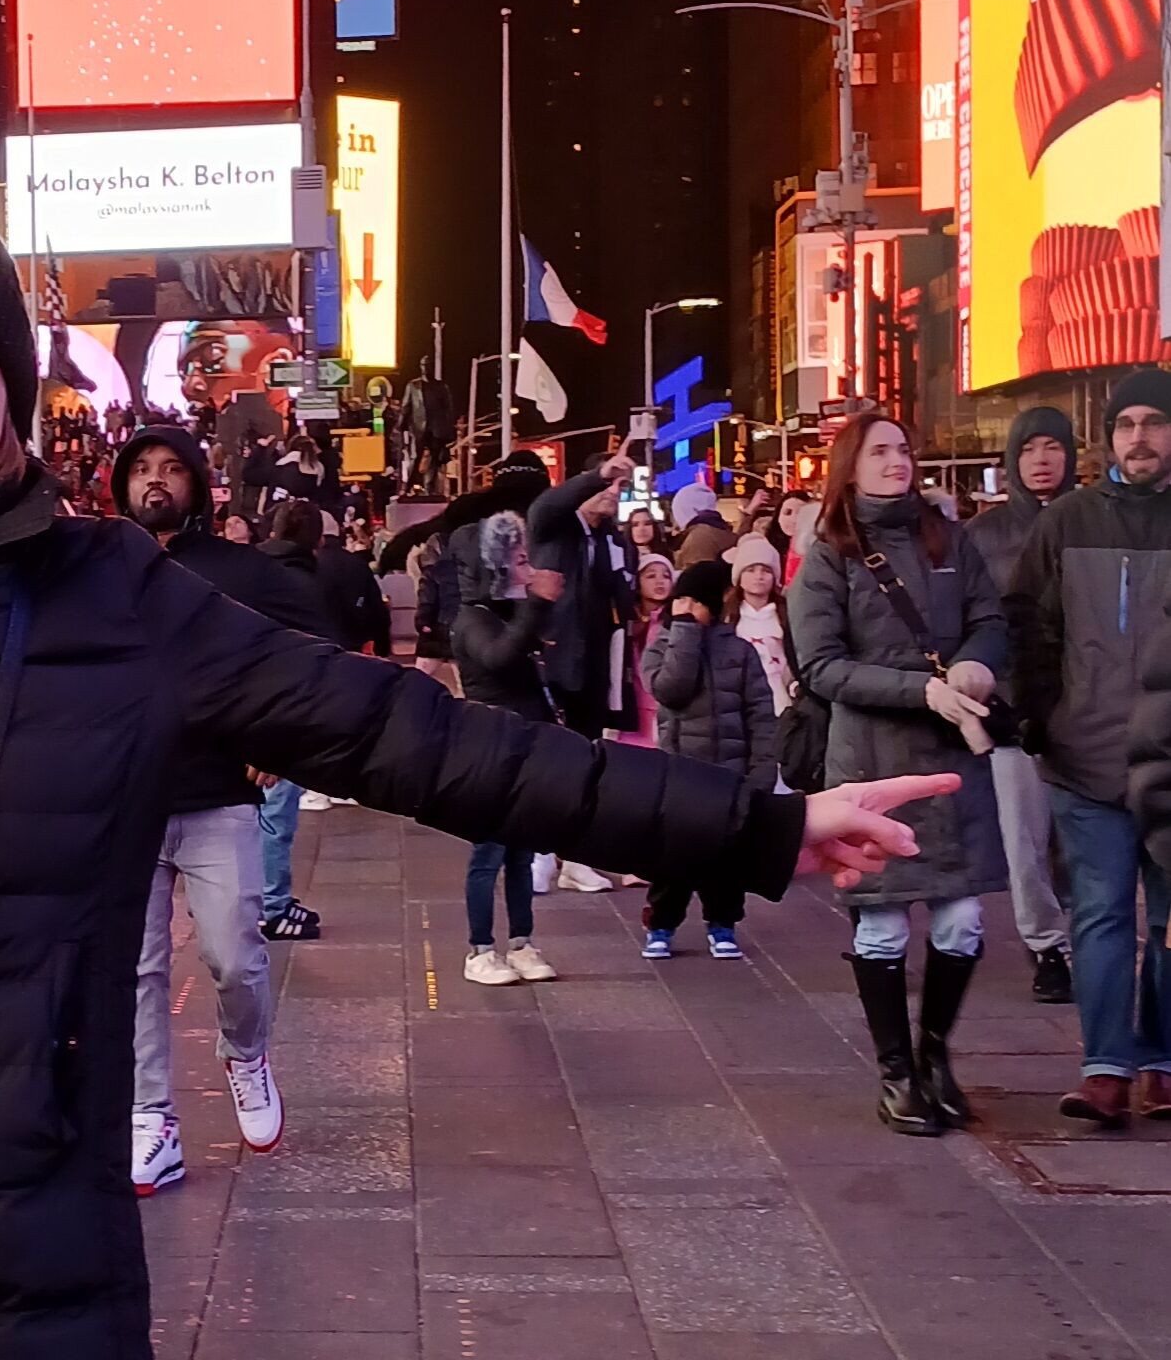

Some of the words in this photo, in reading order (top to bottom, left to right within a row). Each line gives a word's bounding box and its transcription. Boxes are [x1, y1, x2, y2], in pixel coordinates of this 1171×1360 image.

[347, 124, 377, 153] in
[26, 166, 151, 196] Malaysha
[162, 166, 184, 187] K.
[194, 161, 276, 187] Belton
